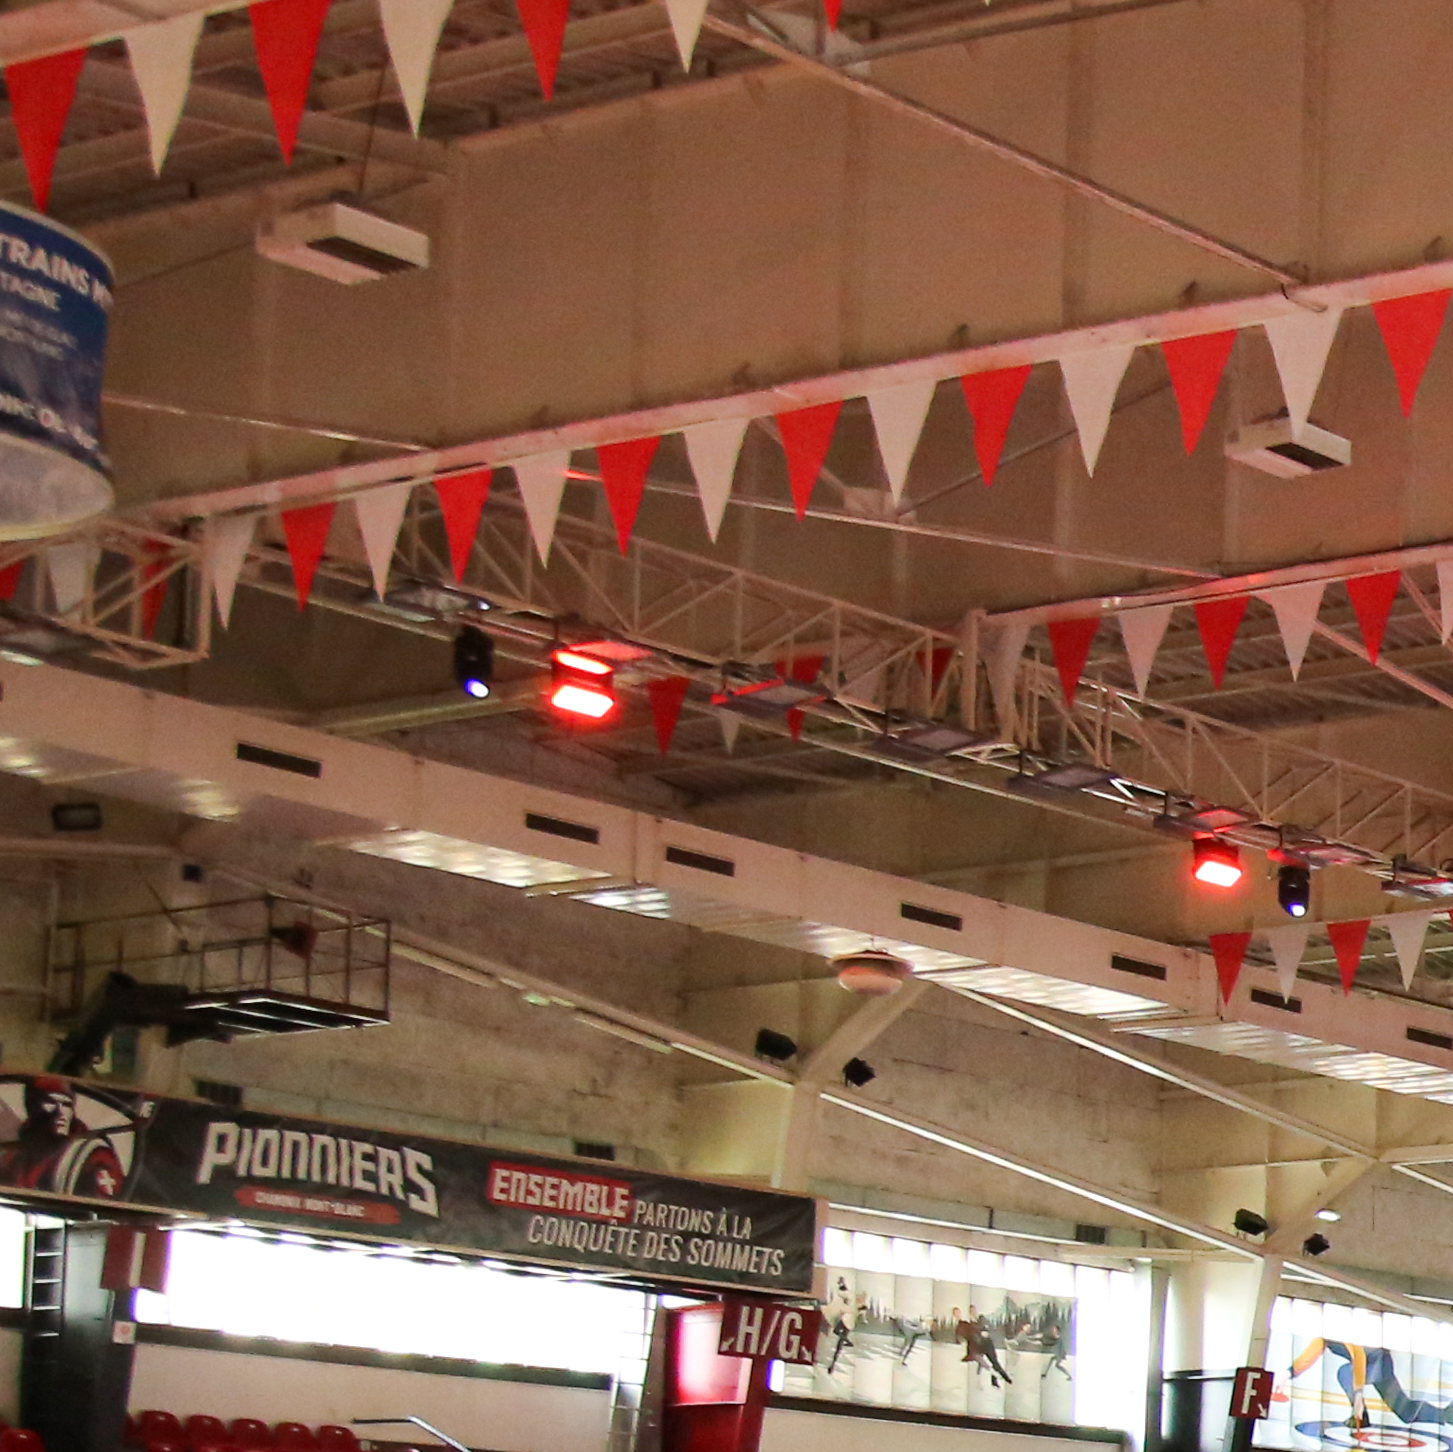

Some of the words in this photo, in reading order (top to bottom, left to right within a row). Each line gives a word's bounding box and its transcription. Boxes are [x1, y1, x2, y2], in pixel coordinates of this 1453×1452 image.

[196, 1121, 440, 1218] PIONNIERS
[491, 1168, 630, 1218] ENSEMBLE
[633, 1200, 713, 1234] PARTONS
[717, 1207, 728, 1238] À
[732, 1216, 752, 1240] LA
[528, 1213, 641, 1258] CONQUÊTE
[644, 1231, 685, 1263] DES
[686, 1237, 785, 1277] SOMMETS
[735, 1305, 802, 1360] H/G
[1241, 1372, 1258, 1414] F
